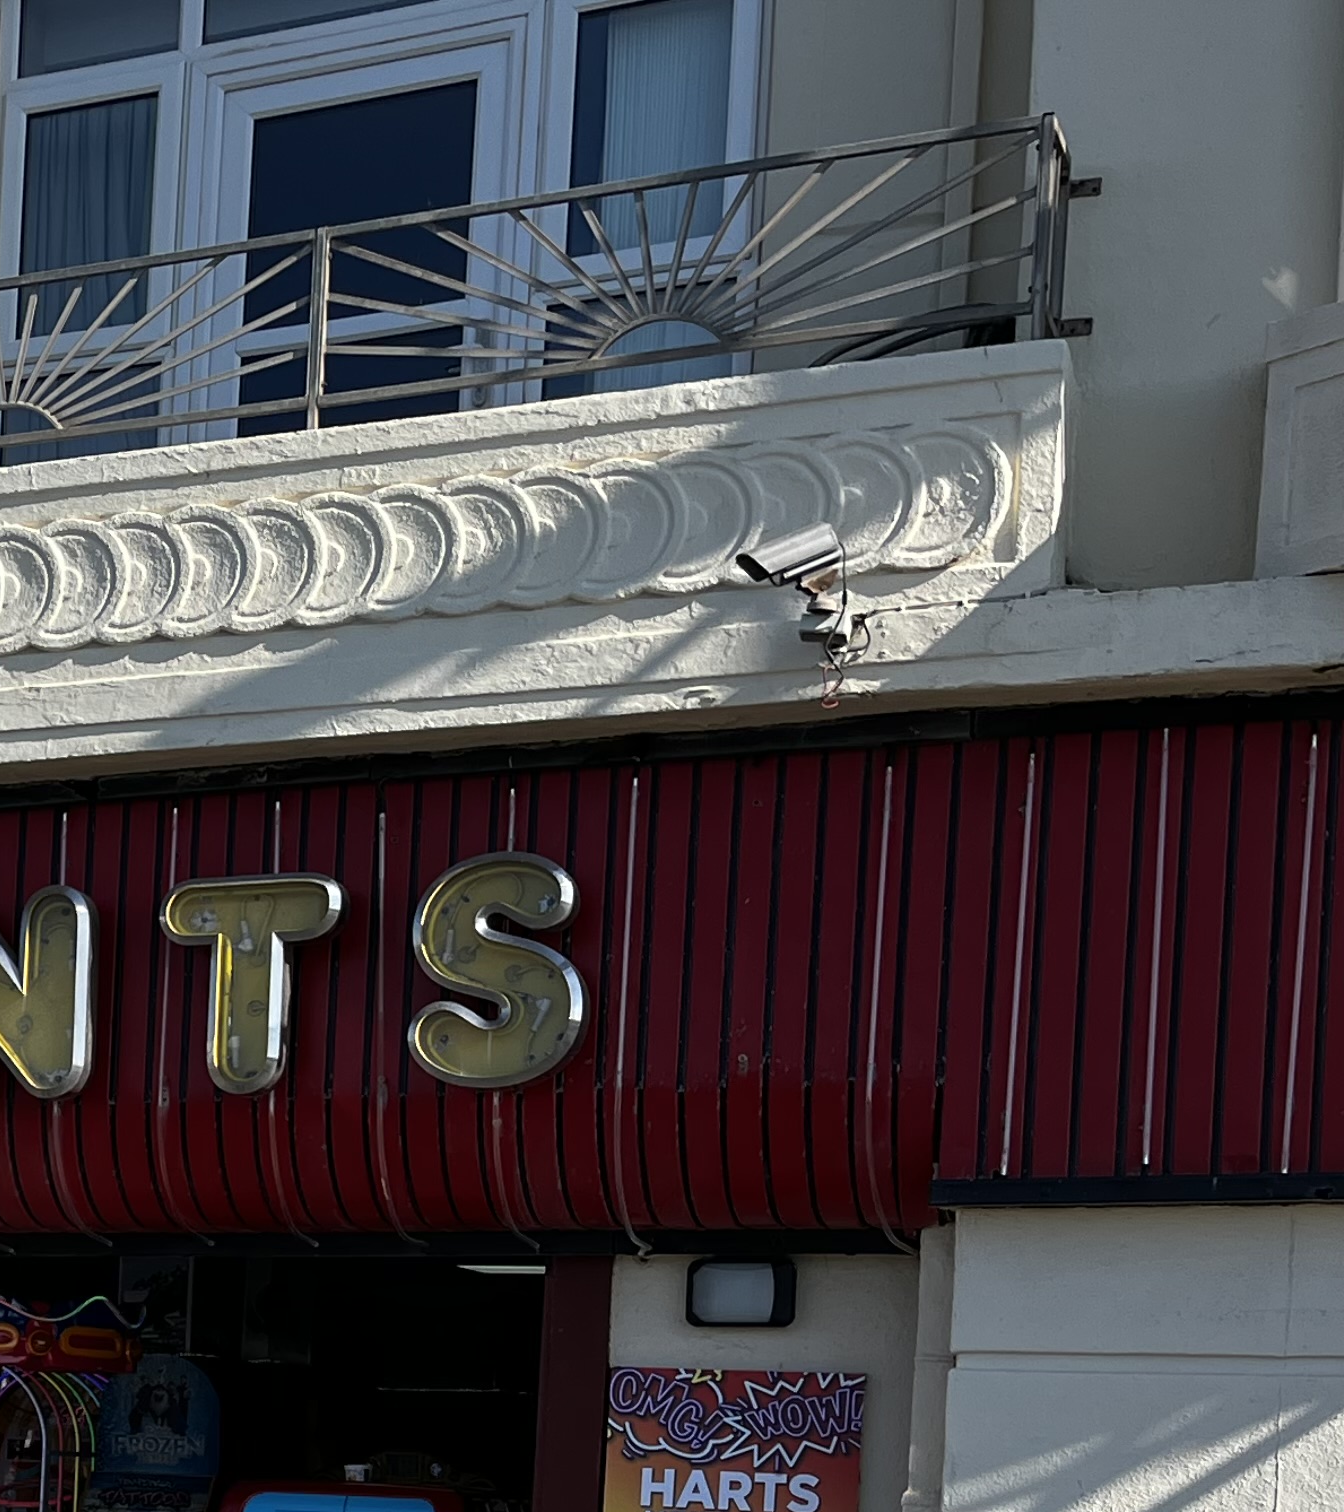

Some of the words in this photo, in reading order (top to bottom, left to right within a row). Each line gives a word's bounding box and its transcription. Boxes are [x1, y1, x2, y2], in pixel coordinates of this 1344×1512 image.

[609, 1368, 726, 1449] OMG!
[744, 1387, 866, 1440] WOW!
[112, 1433, 205, 1457] FROZEN
